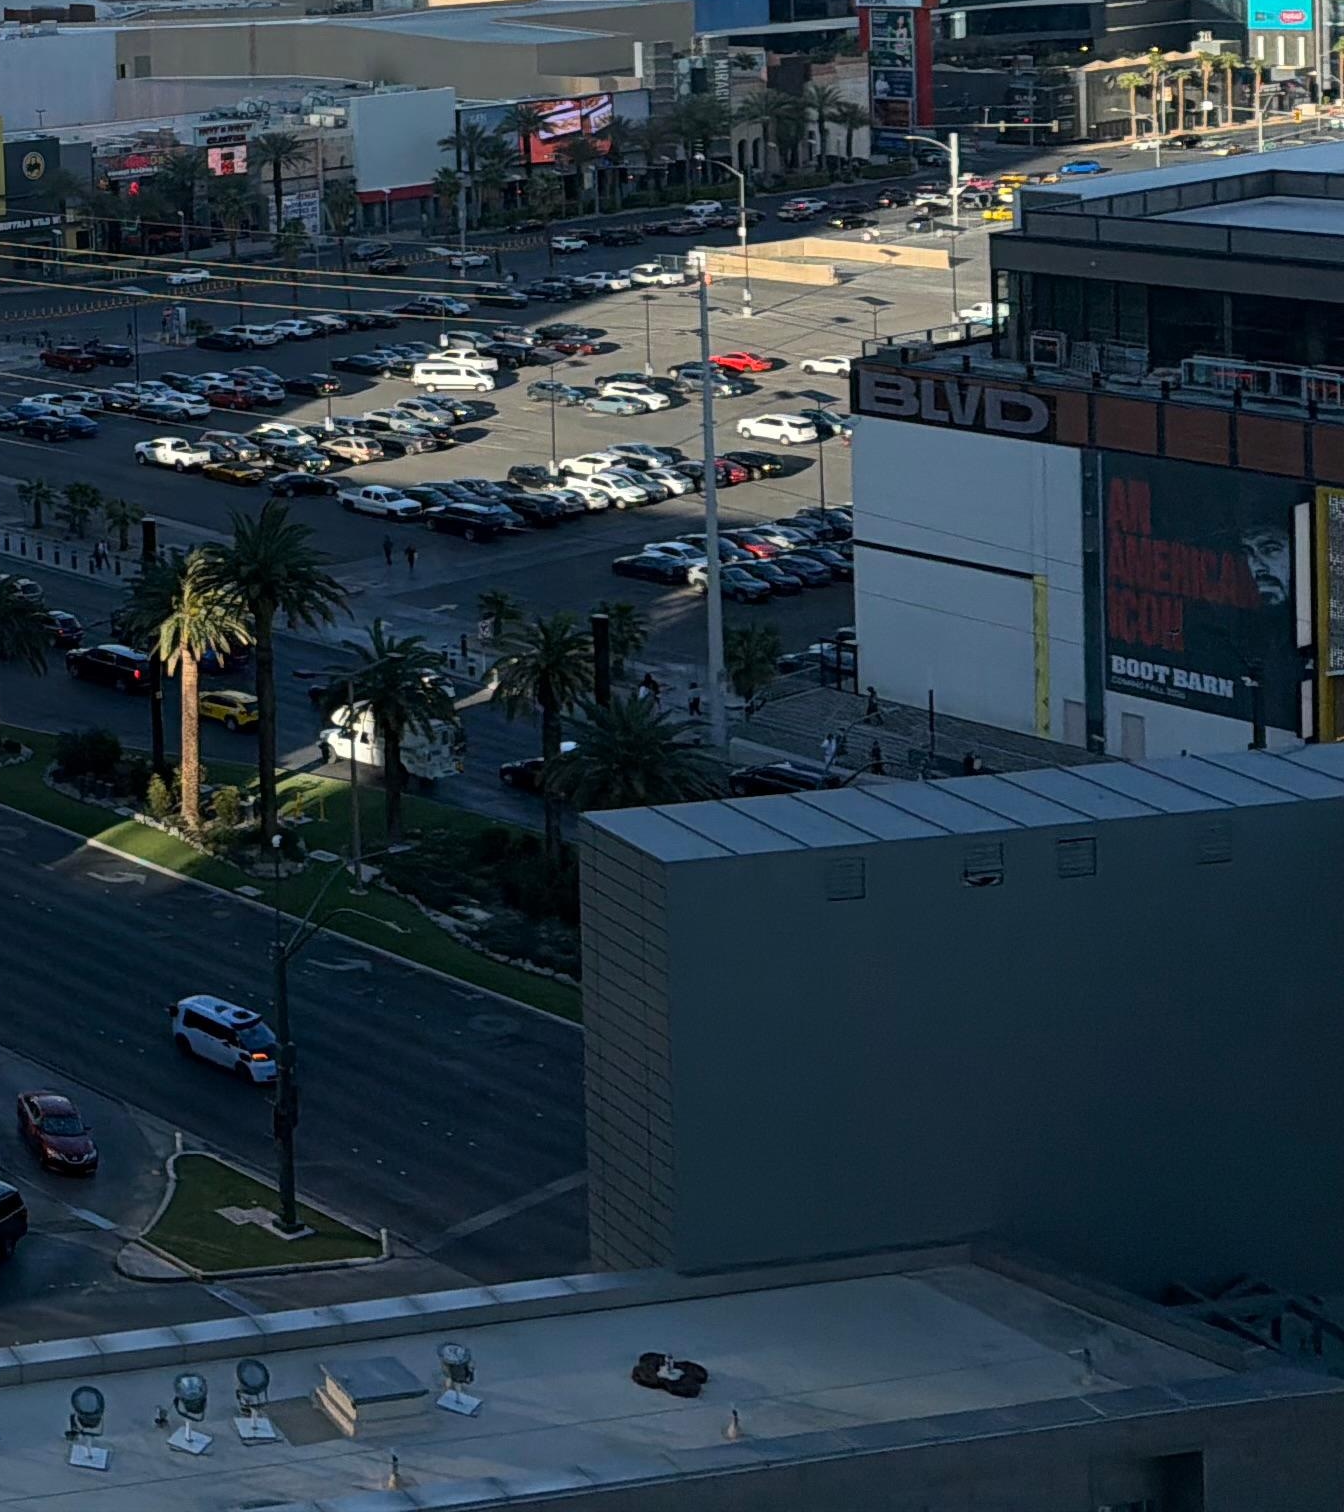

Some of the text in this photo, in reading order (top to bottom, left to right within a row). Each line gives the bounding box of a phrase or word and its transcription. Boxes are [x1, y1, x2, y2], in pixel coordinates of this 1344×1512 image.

[858, 371, 1049, 434] BLVD
[1111, 654, 1170, 684] BOOT
[1173, 667, 1234, 699] BARN
